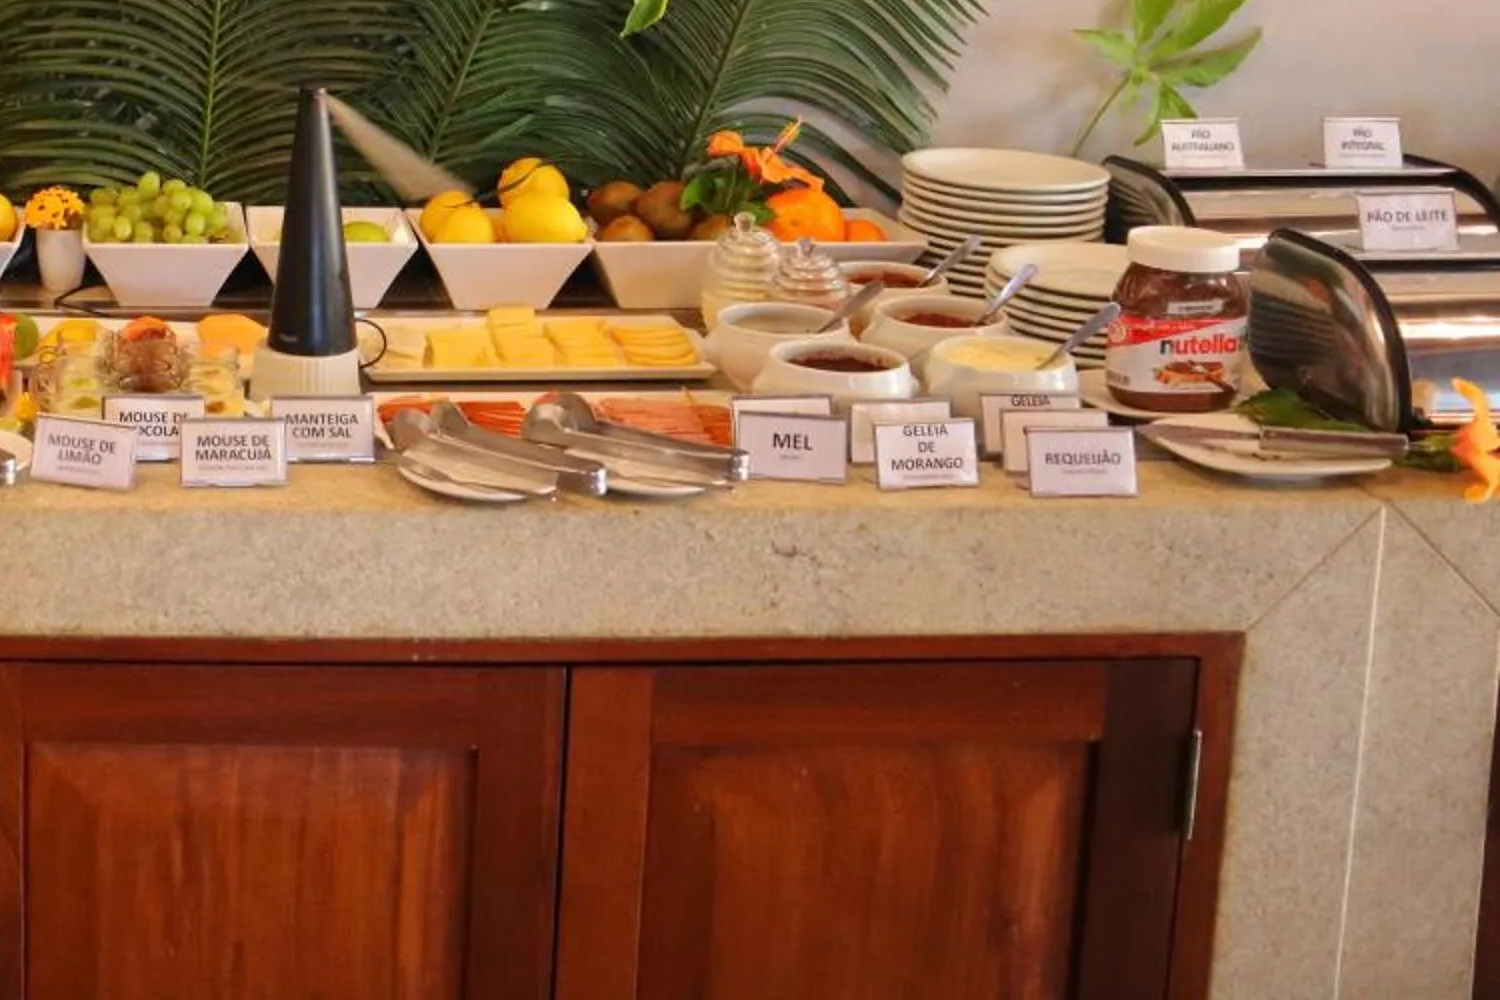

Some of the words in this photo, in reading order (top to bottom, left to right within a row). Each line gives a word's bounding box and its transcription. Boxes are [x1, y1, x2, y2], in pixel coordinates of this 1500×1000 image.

[1396, 210, 1411, 222] DE
[1415, 209, 1448, 222] LEITE
[1160, 334, 1237, 355] nutella
[119, 411, 169, 424] MOUSE
[285, 413, 359, 426] MANTEIGA
[291, 426, 325, 439] COM
[329, 427, 352, 439] SAL
[902, 424, 949, 437] GELEIA
[48, 433, 95, 450] MOUSE
[99, 440, 117, 454] DE
[197, 434, 248, 448] MOUSE
[251, 435, 270, 447] DE
[772, 433, 813, 451] MEL
[917, 441, 936, 453] DE
[56, 449, 102, 465] LIMÃO
[891, 457, 964, 471] MORANGO
[1045, 448, 1122, 466] REQUEIJÃO
